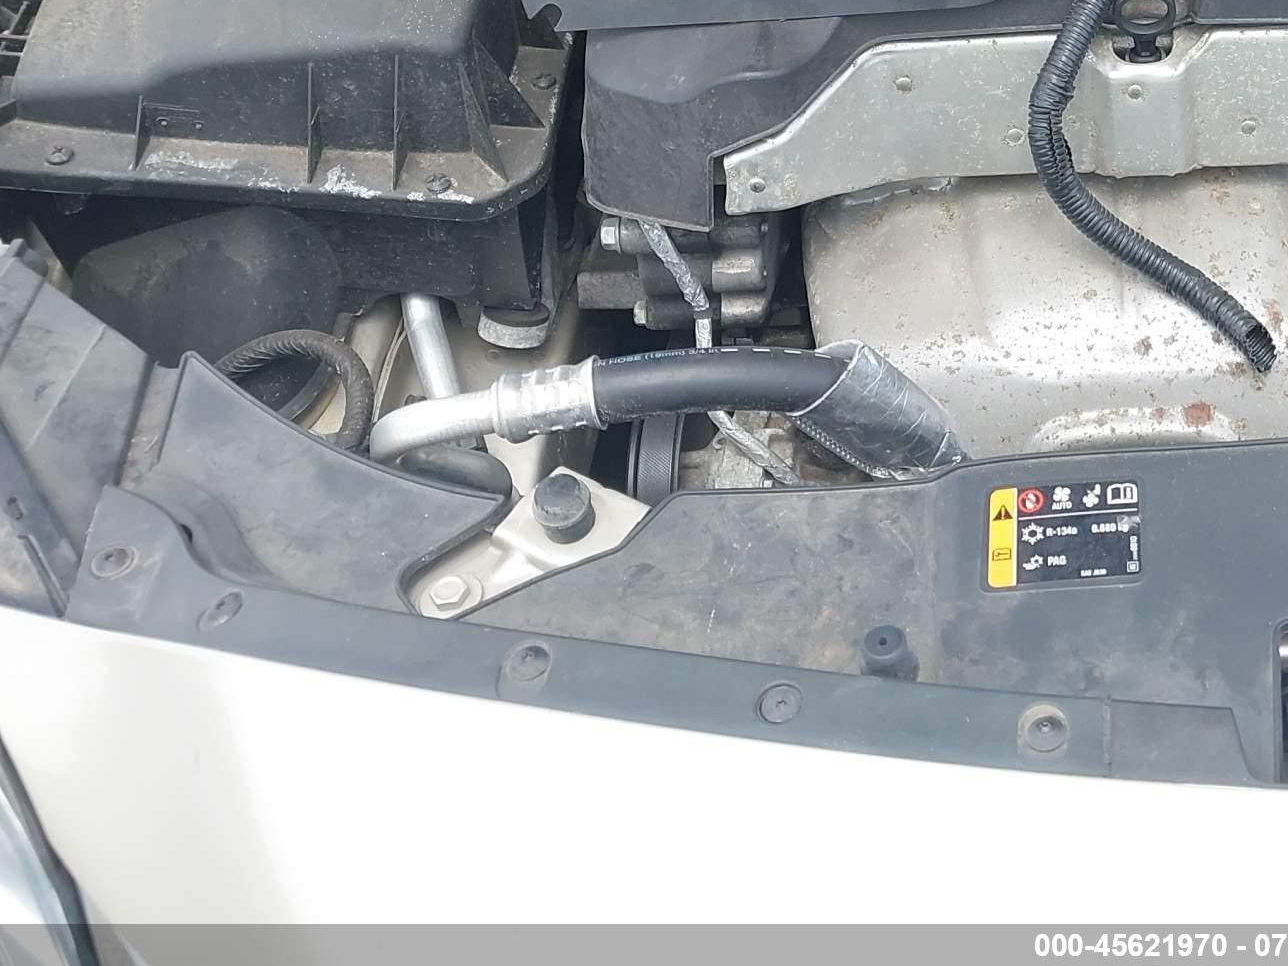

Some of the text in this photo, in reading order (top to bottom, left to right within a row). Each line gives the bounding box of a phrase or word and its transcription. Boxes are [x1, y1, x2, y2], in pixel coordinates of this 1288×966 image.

[1051, 501, 1073, 511] AUTO
[1046, 526, 1079, 537] R-134a
[1047, 554, 1067, 567] PAG
